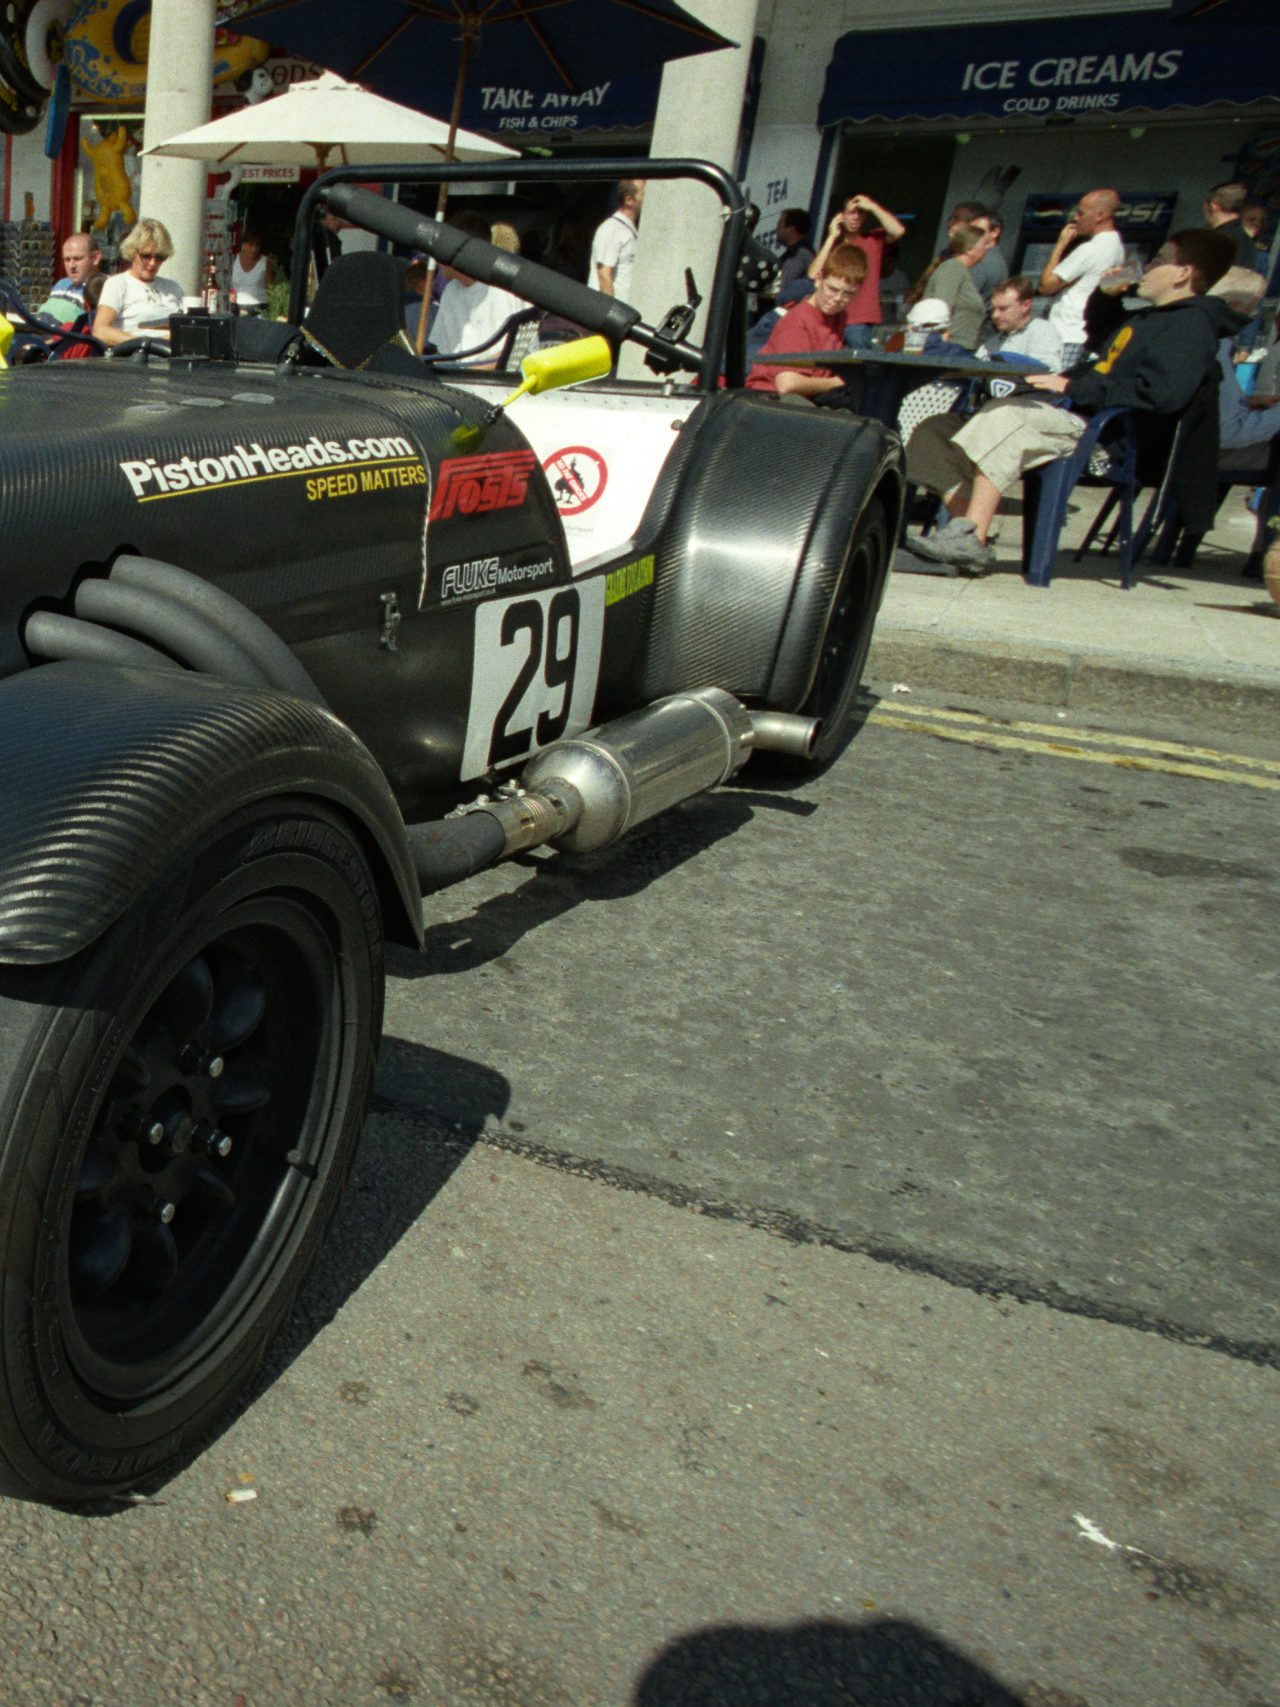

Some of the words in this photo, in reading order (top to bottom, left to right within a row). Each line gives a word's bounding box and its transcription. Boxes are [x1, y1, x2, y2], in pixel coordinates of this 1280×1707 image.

[961, 61, 1019, 91] ICE
[1027, 49, 1183, 87] CREAMS
[480, 86, 534, 110] TAKE
[1002, 96, 1049, 112] COLD
[1055, 93, 1120, 110] DRINKS
[498, 117, 525, 129] FISH
[528, 116, 538, 128] &
[540, 115, 578, 128] CHIPS
[263, 167, 295, 178] PRICES
[767, 178, 788, 206] TEA
[120, 434, 414, 499] PistonHeads.com
[305, 470, 357, 501] SPEED
[360, 464, 427, 494] MATTERS
[441, 557, 500, 598] FLUKE
[497, 558, 554, 584] Motorsport
[487, 589, 581, 768] 29
